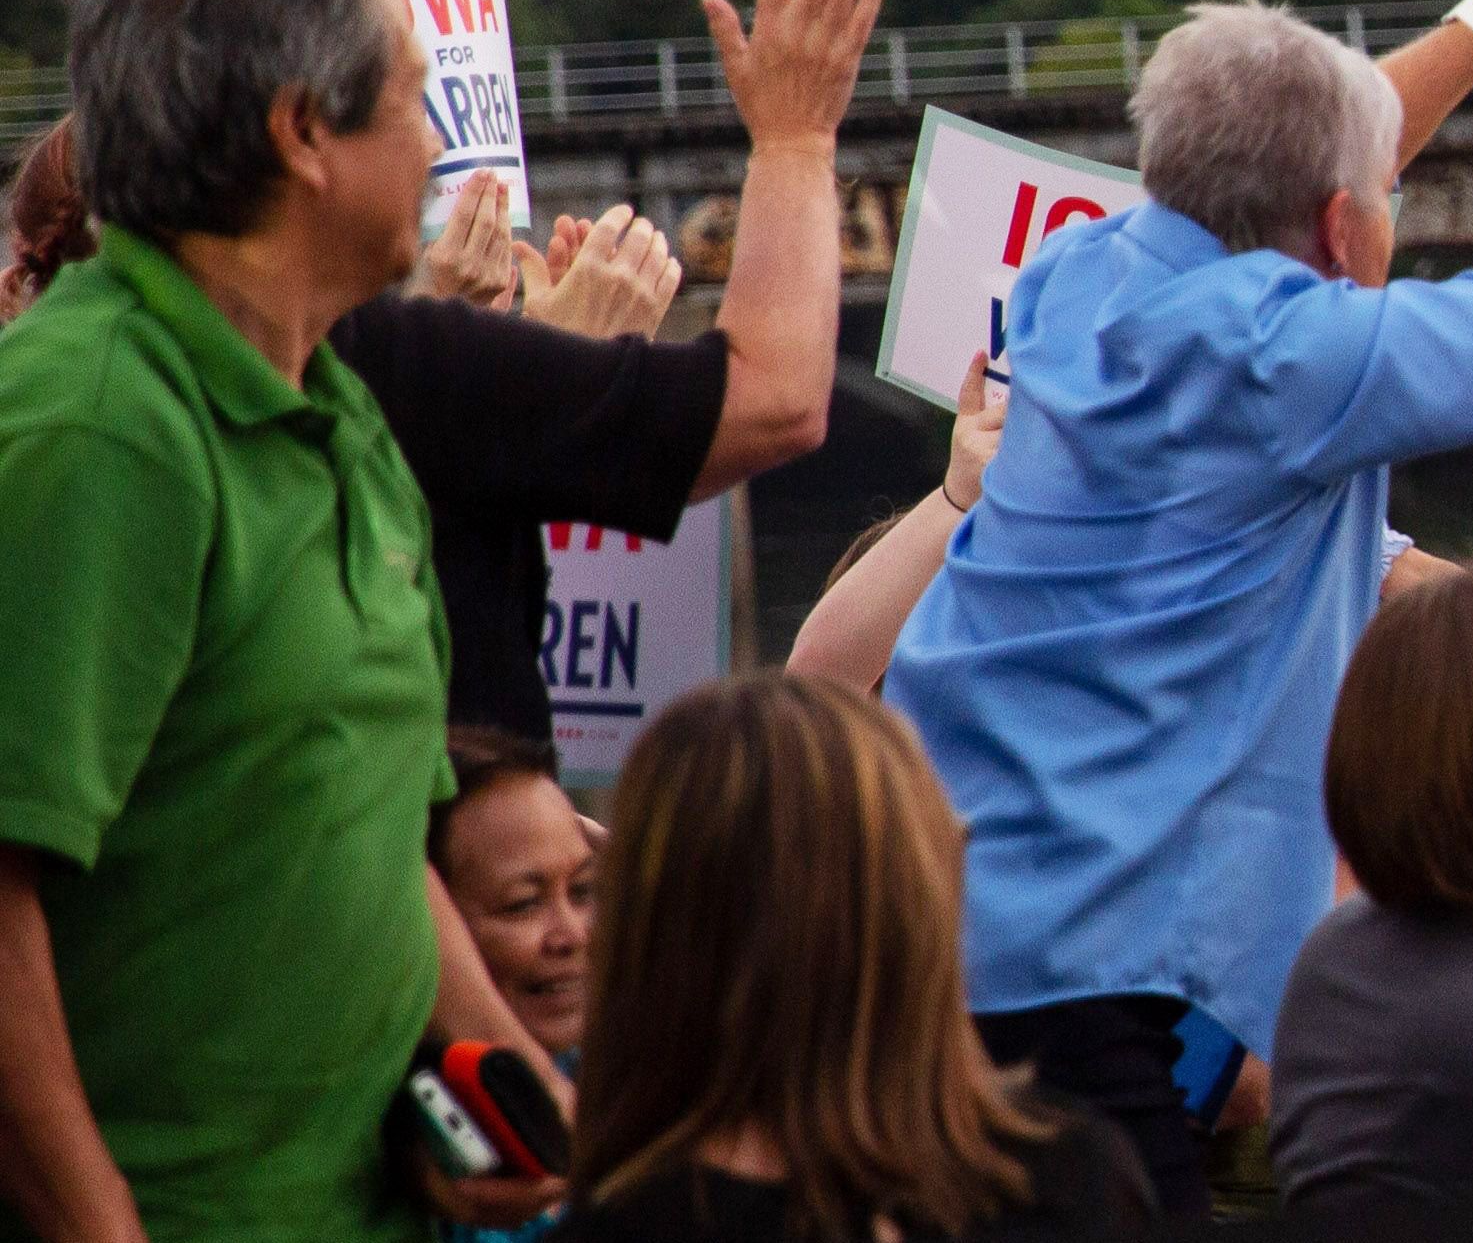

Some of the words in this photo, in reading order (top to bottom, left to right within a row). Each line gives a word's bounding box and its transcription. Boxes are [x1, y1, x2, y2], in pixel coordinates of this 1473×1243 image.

[435, 45, 476, 67] FOR
[423, 73, 517, 151] RREN
[538, 599, 640, 691] REN
